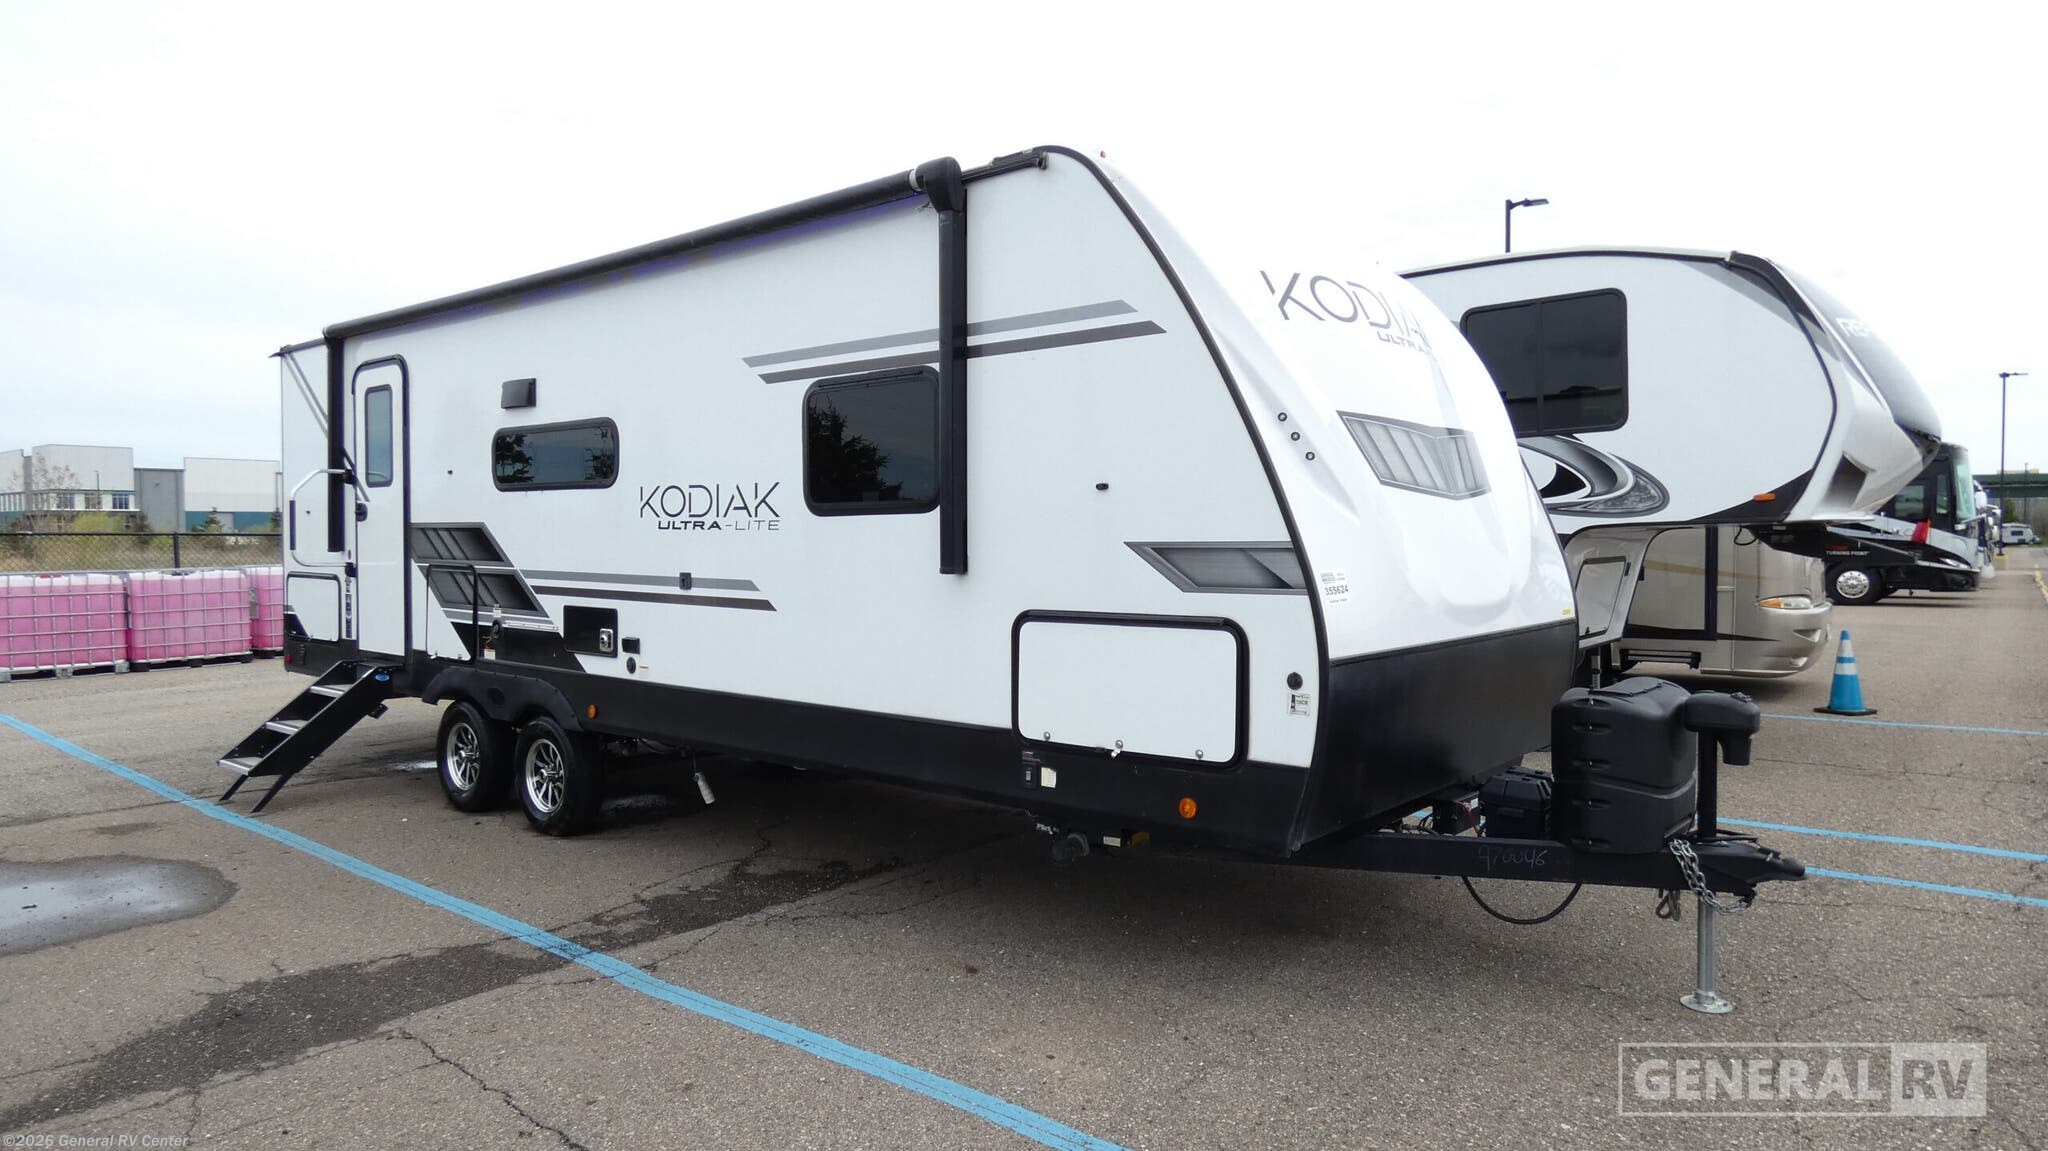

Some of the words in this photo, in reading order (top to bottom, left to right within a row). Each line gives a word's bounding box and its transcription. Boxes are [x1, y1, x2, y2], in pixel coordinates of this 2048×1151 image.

[1259, 270, 1432, 349] KODIA
[640, 482, 780, 518] KODIAK
[658, 520, 780, 531] ULTRA-LITE
